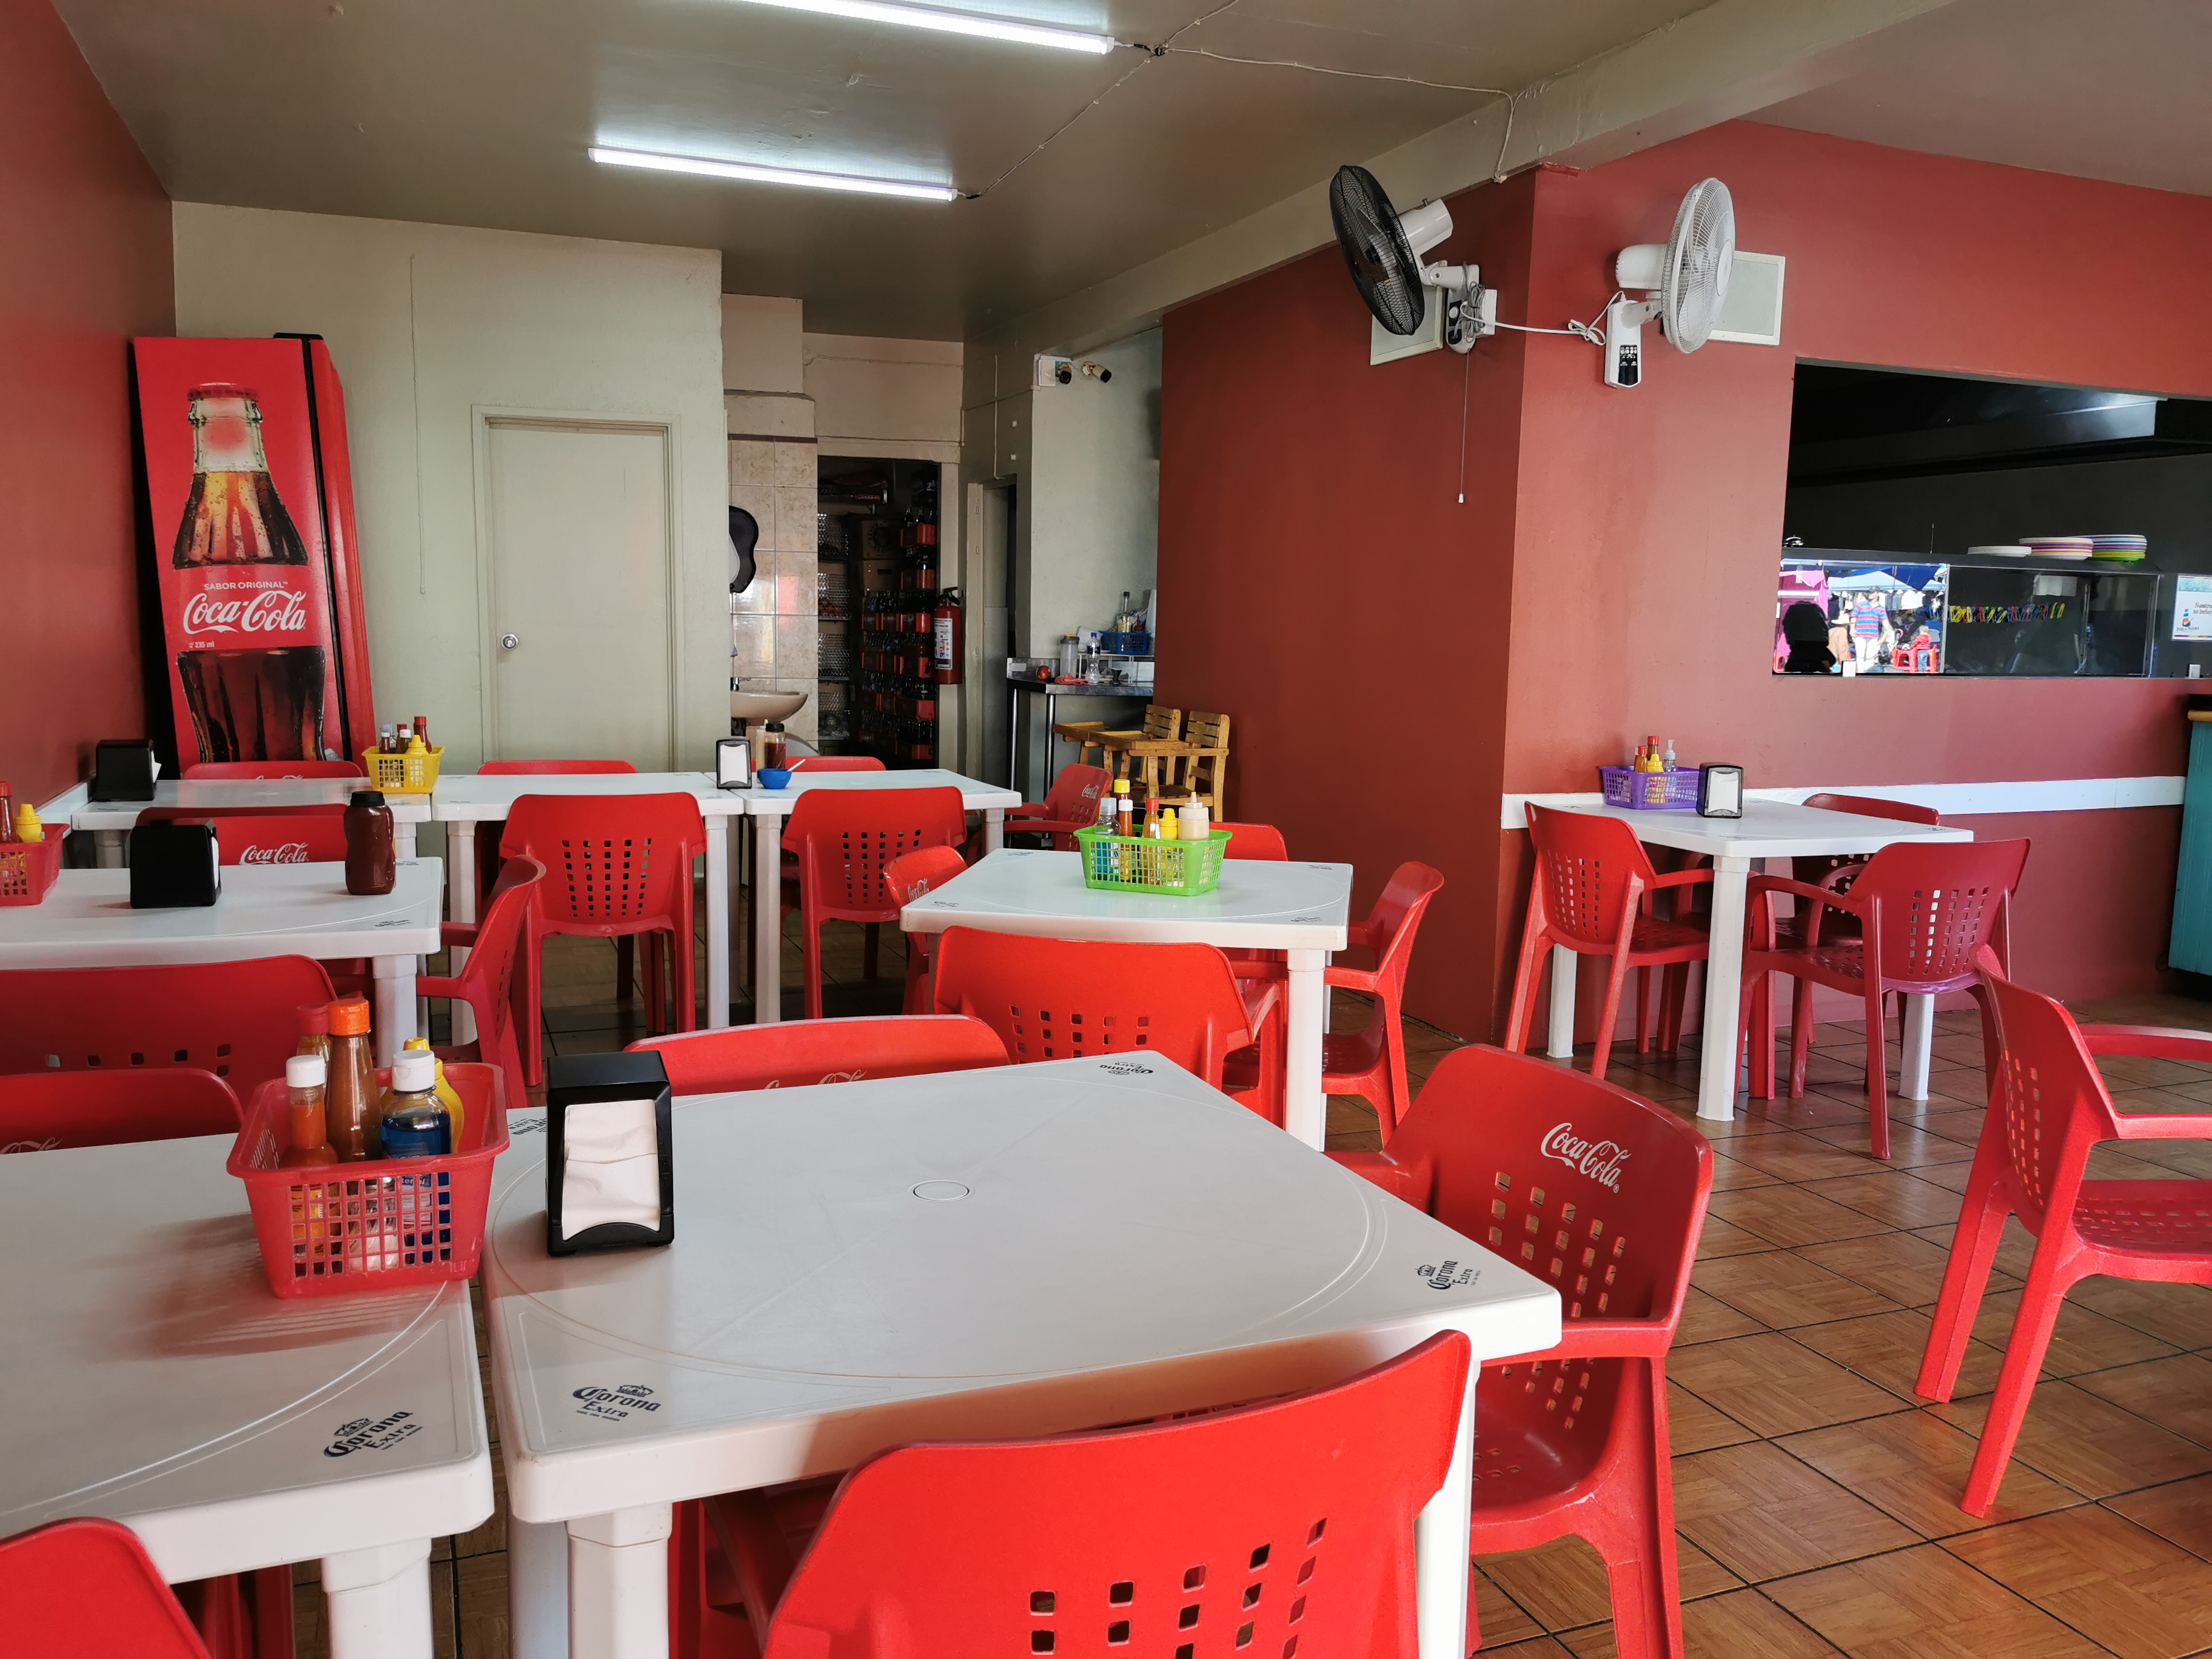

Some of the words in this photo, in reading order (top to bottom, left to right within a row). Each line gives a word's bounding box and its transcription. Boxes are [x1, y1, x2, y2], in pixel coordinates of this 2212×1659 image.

[183, 590, 307, 635] Coca-Cola
[240, 842, 309, 865] Coca-Cola
[1541, 1122, 1632, 1187] Coca-Cola
[1427, 1261, 1459, 1290] Corona
[1452, 1269, 1473, 1285] Extra
[573, 1386, 662, 1412] Corona
[581, 1401, 629, 1418] Extra
[324, 1411, 414, 1458] Corona
[363, 1424, 417, 1449] Extra
